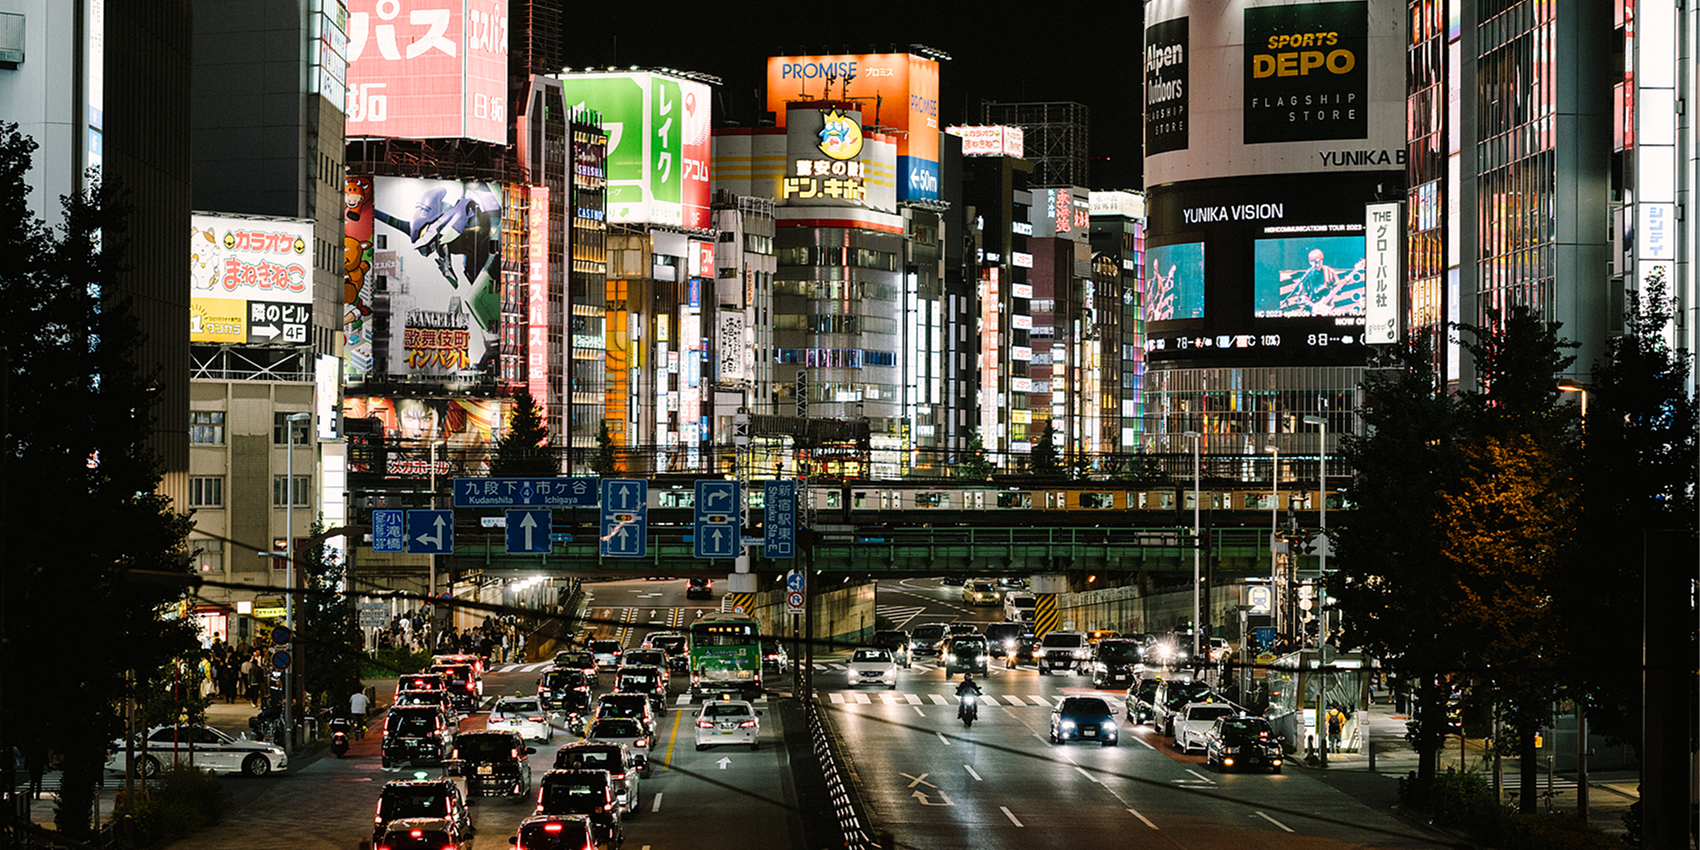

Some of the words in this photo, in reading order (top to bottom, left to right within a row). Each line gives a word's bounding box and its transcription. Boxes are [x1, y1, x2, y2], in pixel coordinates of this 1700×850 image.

[469, 4, 507, 54] エスパス
[1267, 31, 1339, 49] SPORTS
[1146, 43, 1183, 76] Alpen
[1253, 49, 1356, 79] DEPO
[782, 62, 857, 79] PROMISE
[865, 67, 894, 77] プロミス
[1147, 76, 1183, 105] Outdoors
[1253, 93, 1356, 108] FLAGSHIP
[910, 94, 937, 117] PROMISE
[1289, 110, 1356, 122] STORE
[658, 84, 672, 184] レイク
[1155, 121, 1184, 135] STORE
[1319, 150, 1392, 166] YUNIKA
[577, 164, 604, 178] SHISHA
[683, 158, 709, 182] アコム
[920, 169, 937, 193] 50m
[577, 207, 604, 220] CASINO
[1183, 205, 1229, 224] YUNIKA
[1231, 203, 1284, 220] VISION
[1373, 211, 1391, 222] THE
[530, 196, 543, 257] パチンコ
[234, 230, 296, 254] カラオケ
[223, 257, 306, 292] まねきねこ
[1376, 224, 1388, 308] グローバル社
[251, 303, 310, 324] 隣のビル
[529, 263, 543, 346] エスパス
[206, 323, 242, 335] ワンカラ
[285, 327, 304, 339] 4F
[404, 329, 470, 349] 歌舞伎町
[403, 349, 471, 369] インパクト
[465, 481, 518, 495] 九段下
[523, 488, 530, 496] 4
[468, 496, 514, 505] Kudanshita
[544, 496, 578, 505] Ichigaya
[767, 486, 778, 522] Shinjuku
[778, 484, 791, 554] 新宿駅東口
